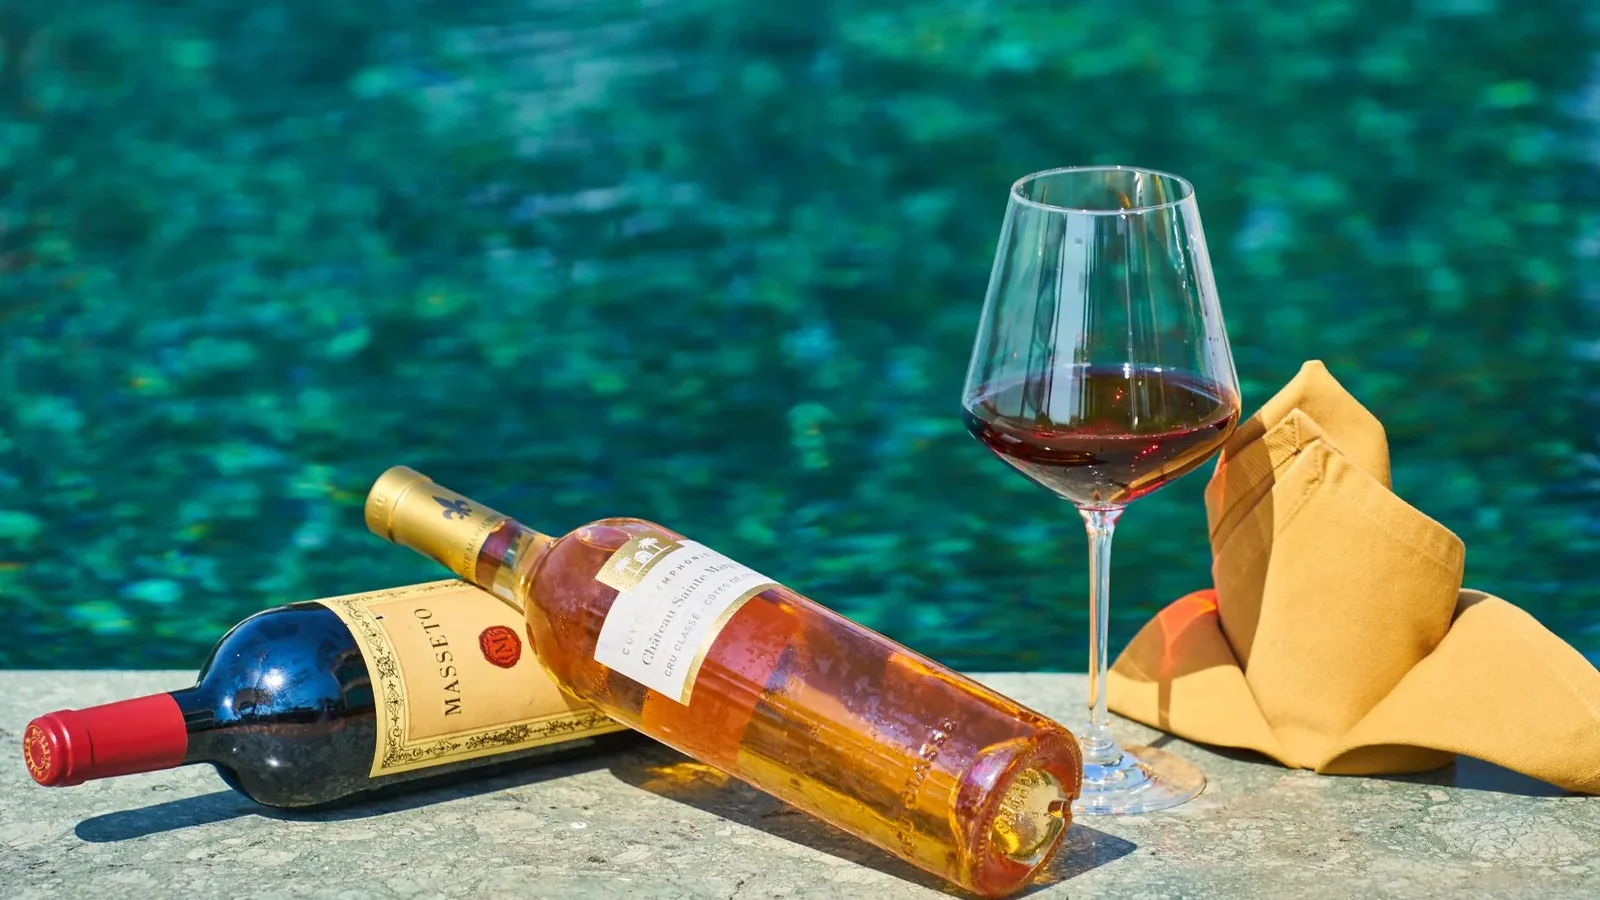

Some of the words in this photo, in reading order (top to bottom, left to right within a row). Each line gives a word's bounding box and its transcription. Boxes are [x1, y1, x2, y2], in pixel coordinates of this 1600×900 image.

[414, 608, 462, 717] MASSETO
[641, 611, 676, 666] Château
[672, 573, 707, 608] Sainte
[664, 655, 677, 678] CRU
[675, 613, 700, 652] CLASSÉ
[705, 582, 729, 605] CÔTES
